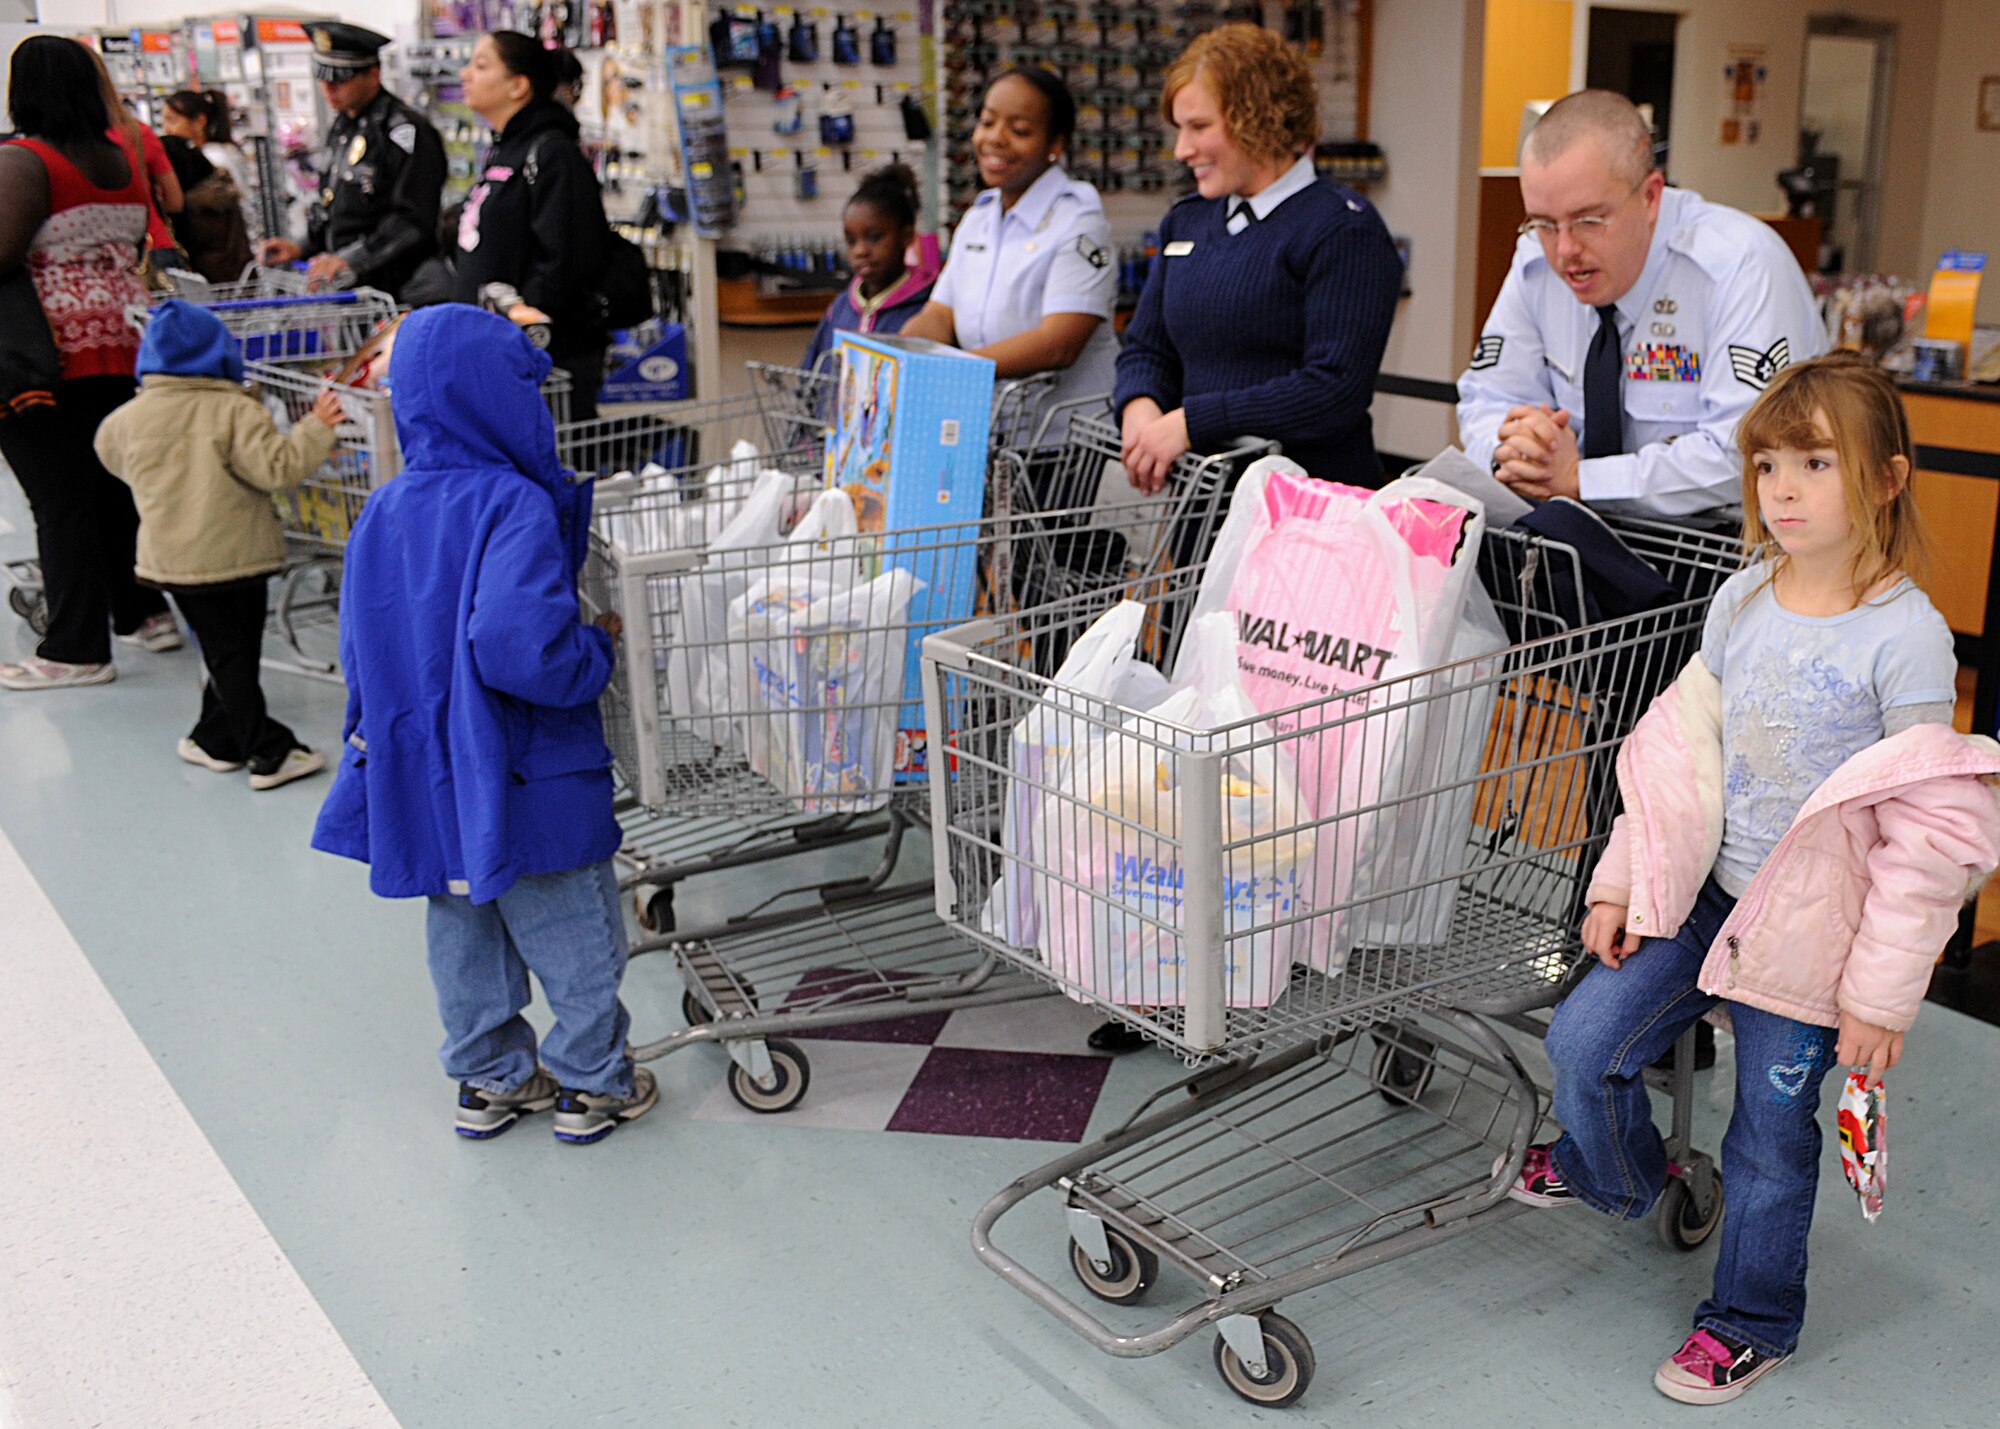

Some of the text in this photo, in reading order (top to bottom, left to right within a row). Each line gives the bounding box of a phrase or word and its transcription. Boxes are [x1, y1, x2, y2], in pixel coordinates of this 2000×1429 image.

[1238, 656, 1256, 674] Sve
[1114, 852, 1260, 902] Walrt
[1141, 891, 1184, 908] mney
